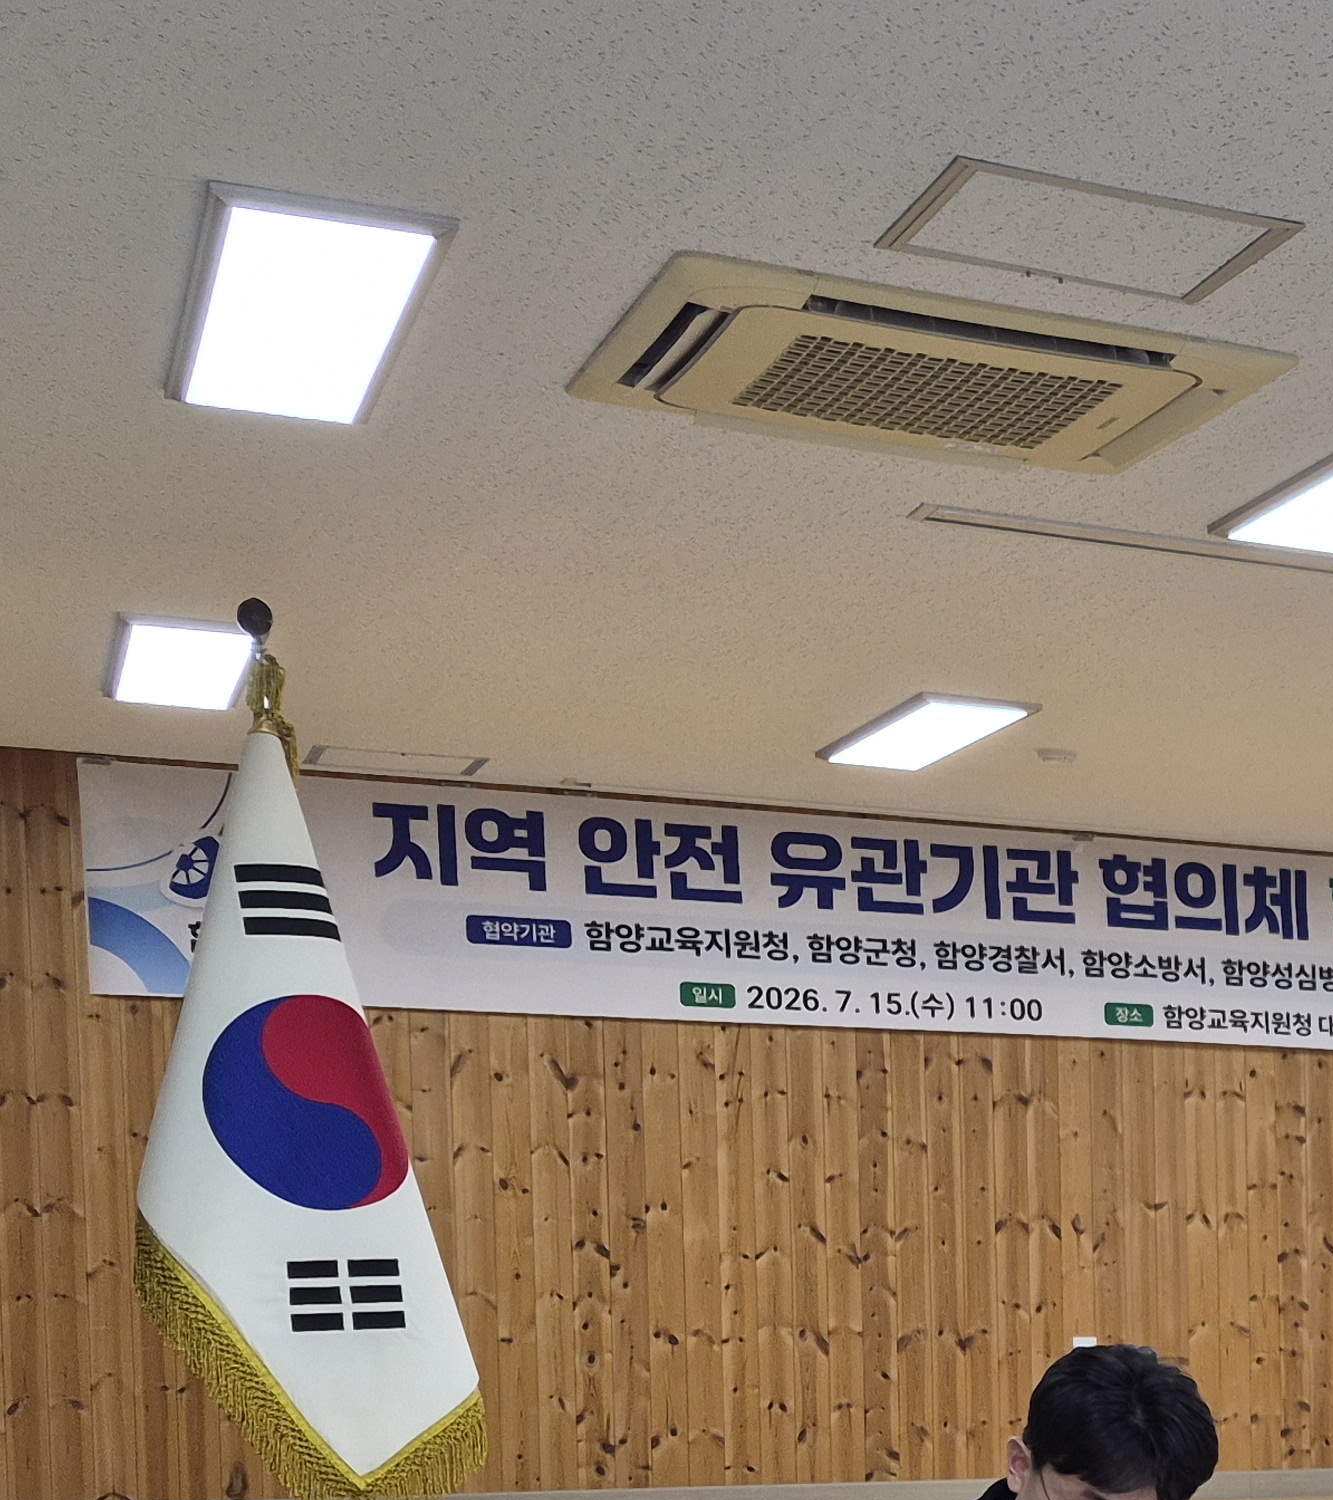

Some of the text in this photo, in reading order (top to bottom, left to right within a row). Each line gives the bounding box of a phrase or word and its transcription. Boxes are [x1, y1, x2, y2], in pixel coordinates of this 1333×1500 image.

[371, 801, 548, 892] 지역
[577, 816, 745, 904] 안전
[769, 830, 1080, 925] 유관기관
[1098, 853, 1310, 941] 협의체
[480, 920, 557, 944] 협약기관
[583, 920, 799, 964] 함양교육지원청,
[806, 933, 927, 971] 함양군청,
[933, 940, 1075, 978] 함양경찰서,
[1080, 948, 1215, 987] 함양소방서,
[691, 987, 723, 1004] 일시
[965, 996, 1043, 1022] 11:00
[1115, 1006, 1143, 1024] 장소
[1162, 1004, 1312, 1037] 함양교육지원청
